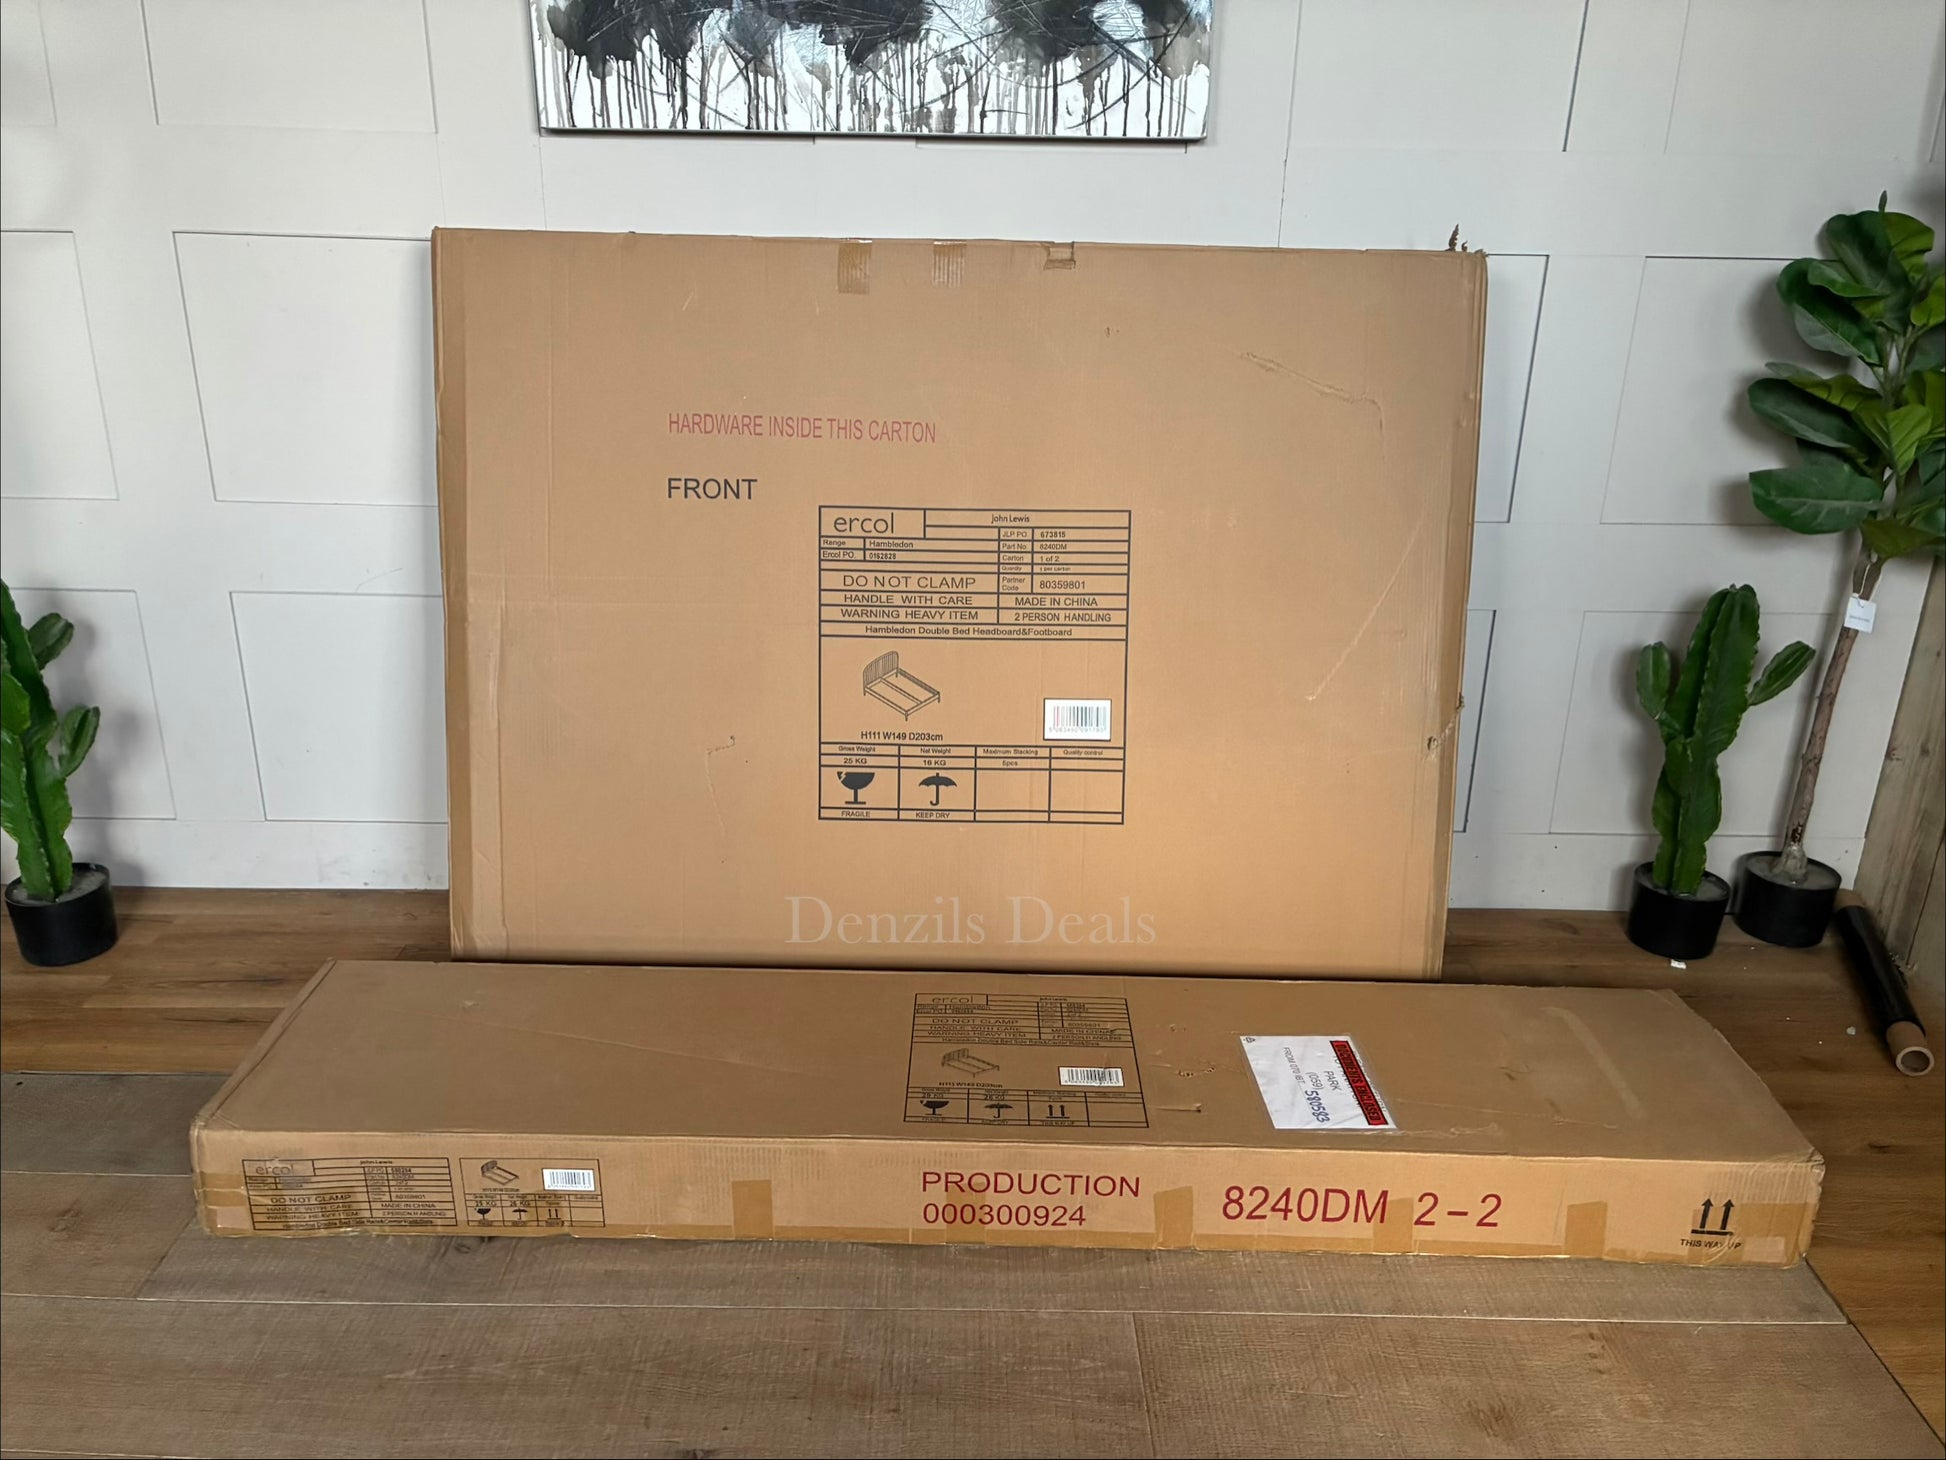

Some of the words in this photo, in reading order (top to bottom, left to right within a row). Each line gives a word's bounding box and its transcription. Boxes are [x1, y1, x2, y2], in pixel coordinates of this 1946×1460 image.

[668, 413, 763, 436] HARDWARE
[769, 416, 823, 438] INSIDE
[827, 418, 863, 439] THIS
[868, 420, 936, 443] CARTON
[667, 477, 758, 500] FRONT
[833, 511, 894, 534] ercol
[1009, 514, 1030, 523] Lewis
[869, 540, 914, 549] Hambledon
[1002, 542, 1016, 550] Part
[822, 551, 841, 559] Ercol
[843, 575, 868, 587] DO
[874, 575, 912, 588] NOT
[917, 576, 976, 589] CLAMP
[1002, 576, 1025, 584] Partner
[1040, 581, 1086, 590] 80359801
[844, 594, 894, 604] HANDLE
[901, 595, 933, 605] WITH
[938, 596, 973, 605] CARE
[1015, 597, 1046, 606] MADE
[1050, 597, 1061, 606] IN
[1064, 597, 1098, 607] CHINA
[841, 608, 900, 619] WARNING
[905, 610, 946, 620] HEAVY
[950, 611, 978, 620] ITEM
[1014, 612, 1020, 621] 2
[1022, 612, 1060, 622] PERSON
[1064, 613, 1111, 622] HANDLING
[865, 625, 916, 634] Hambledon
[918, 627, 950, 635] Double
[953, 627, 970, 635] Bed
[973, 627, 1072, 636] Headboard&Footboard
[861, 731, 881, 740] H111
[882, 732, 906, 740] W149
[909, 732, 943, 741] D203cm
[841, 810, 870, 818] FRAGILE
[932, 995, 974, 1004] ercol
[1284, 1047, 1295, 1064] FROM
[1324, 1070, 1342, 1091] PARK
[1305, 1090, 1331, 1123] 580583
[255, 1163, 294, 1175] ercol
[921, 1171, 1141, 1199] PRODUCTION
[315, 1194, 351, 1203] CLAMP
[1221, 1186, 1389, 1224] 8240DM
[922, 1202, 1087, 1227] 000300924
[1680, 1238, 1702, 1248] THIS
